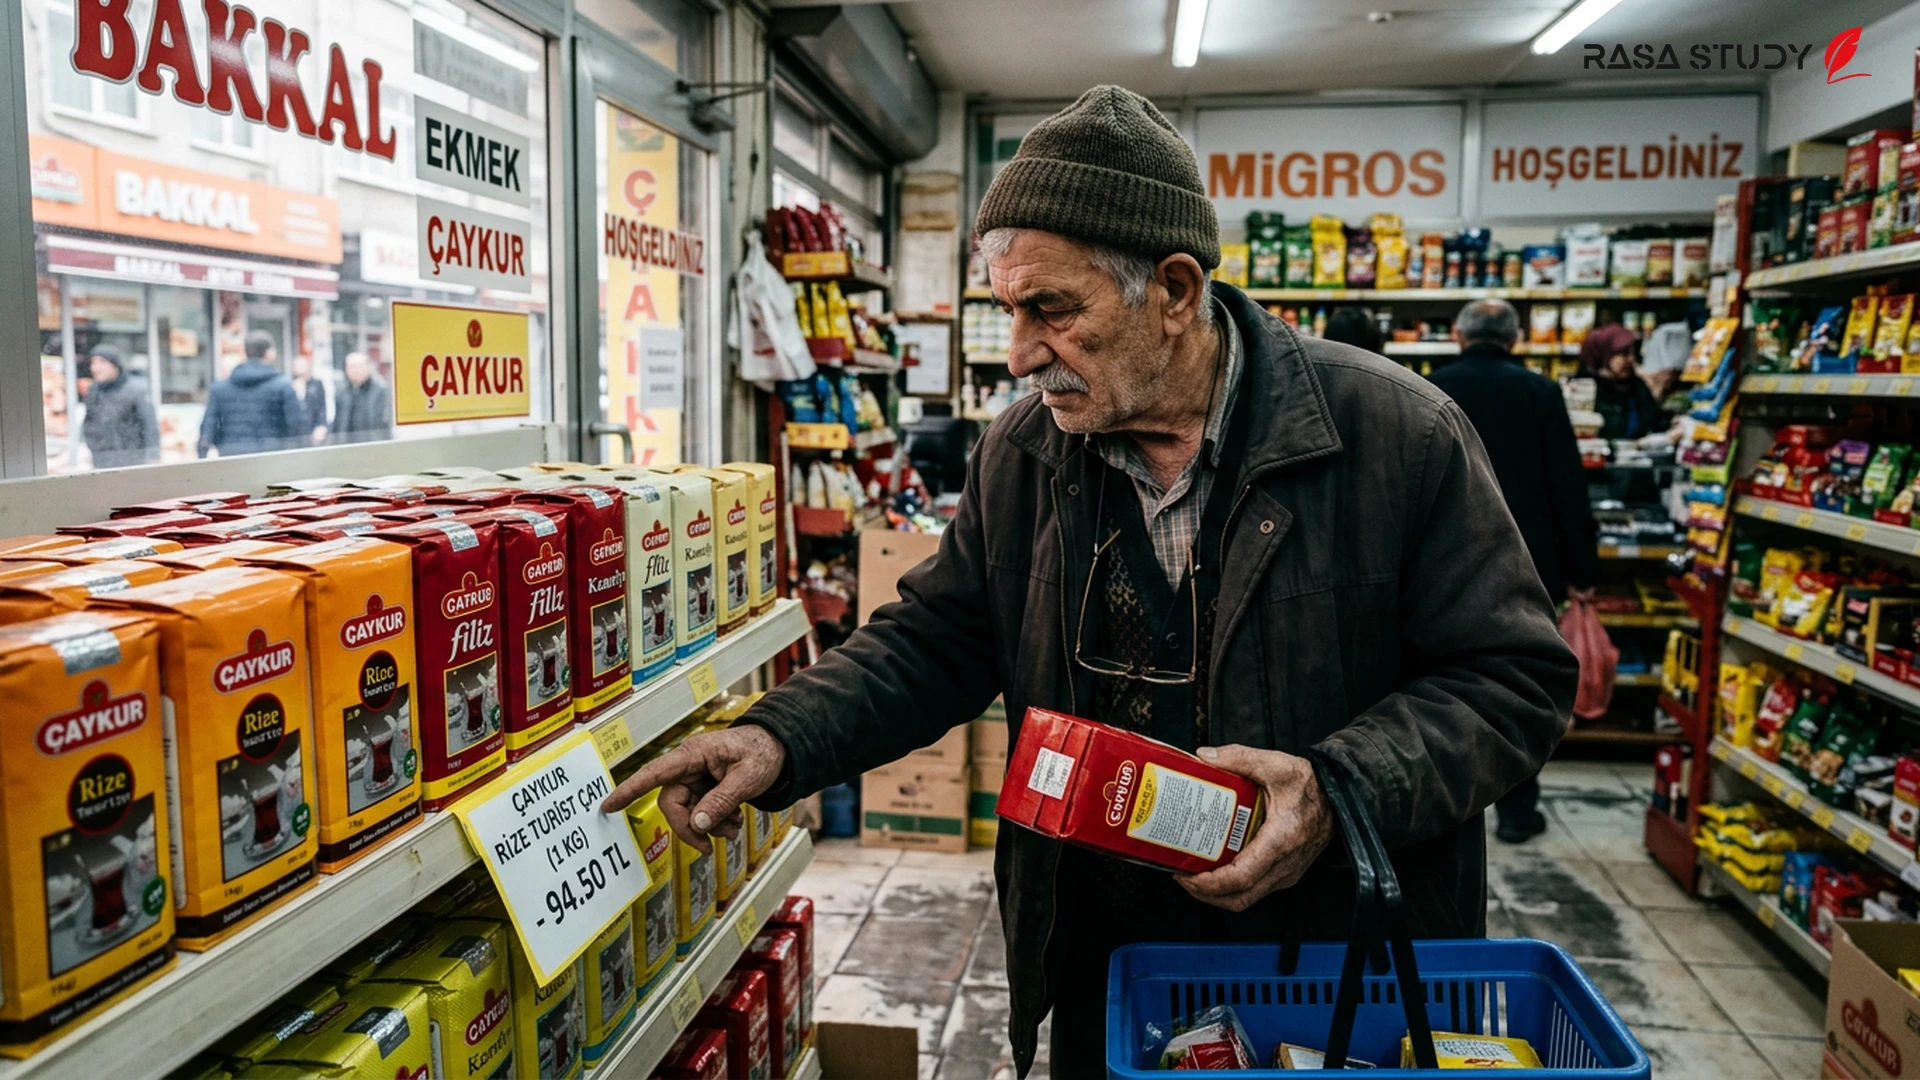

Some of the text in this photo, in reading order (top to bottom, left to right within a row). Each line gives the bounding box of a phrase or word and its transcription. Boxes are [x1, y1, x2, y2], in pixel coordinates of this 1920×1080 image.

[70, 0, 396, 163] BAKKAL
[425, 117, 521, 193] EKMEK
[1492, 132, 1744, 190] HOŞGELDİNİZ
[115, 170, 259, 234] BAKKAL
[427, 215, 525, 276] ÇAYKUR
[420, 354, 524, 409] ÇAYKUR
[220, 648, 292, 690] ÇAYKUR
[447, 619, 493, 663] filiz
[44, 699, 144, 754] ÇAYKUR
[79, 772, 127, 803] Rize
[512, 766, 570, 817] ÇAYKUR
[494, 776, 609, 865] RİZE TURİST ÇAYI
[546, 826, 589, 872] (1 KG)
[545, 859, 606, 925] 94.50
[602, 842, 631, 876] TL
